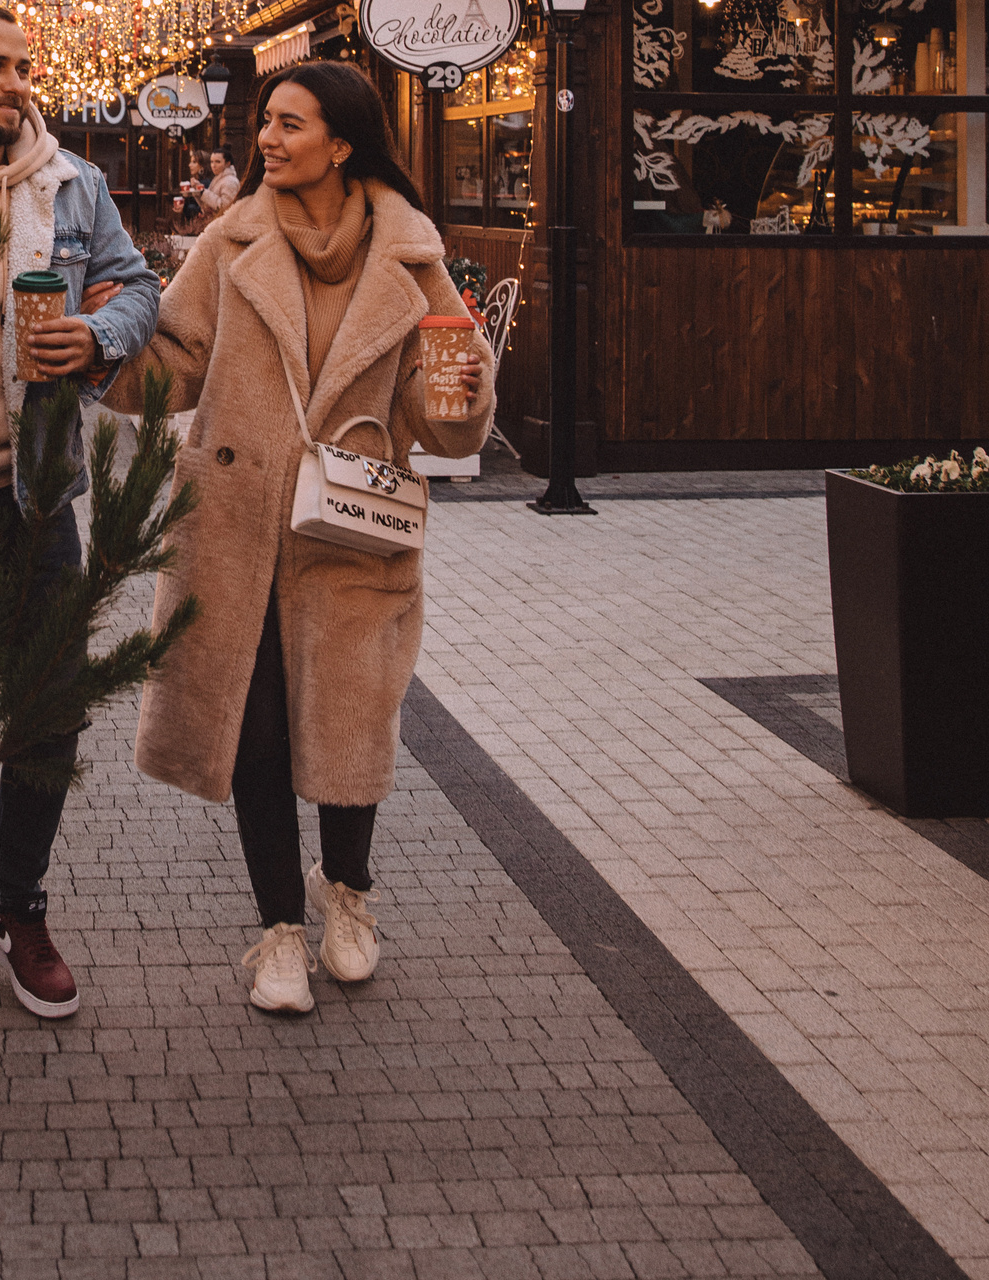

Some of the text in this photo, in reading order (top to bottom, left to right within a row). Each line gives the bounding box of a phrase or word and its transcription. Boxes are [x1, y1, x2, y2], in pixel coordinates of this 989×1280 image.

[372, 13, 508, 53] Chocolatier
[427, 65, 462, 88] 29
[326, 497, 419, 534] "CASH INSIDE"
